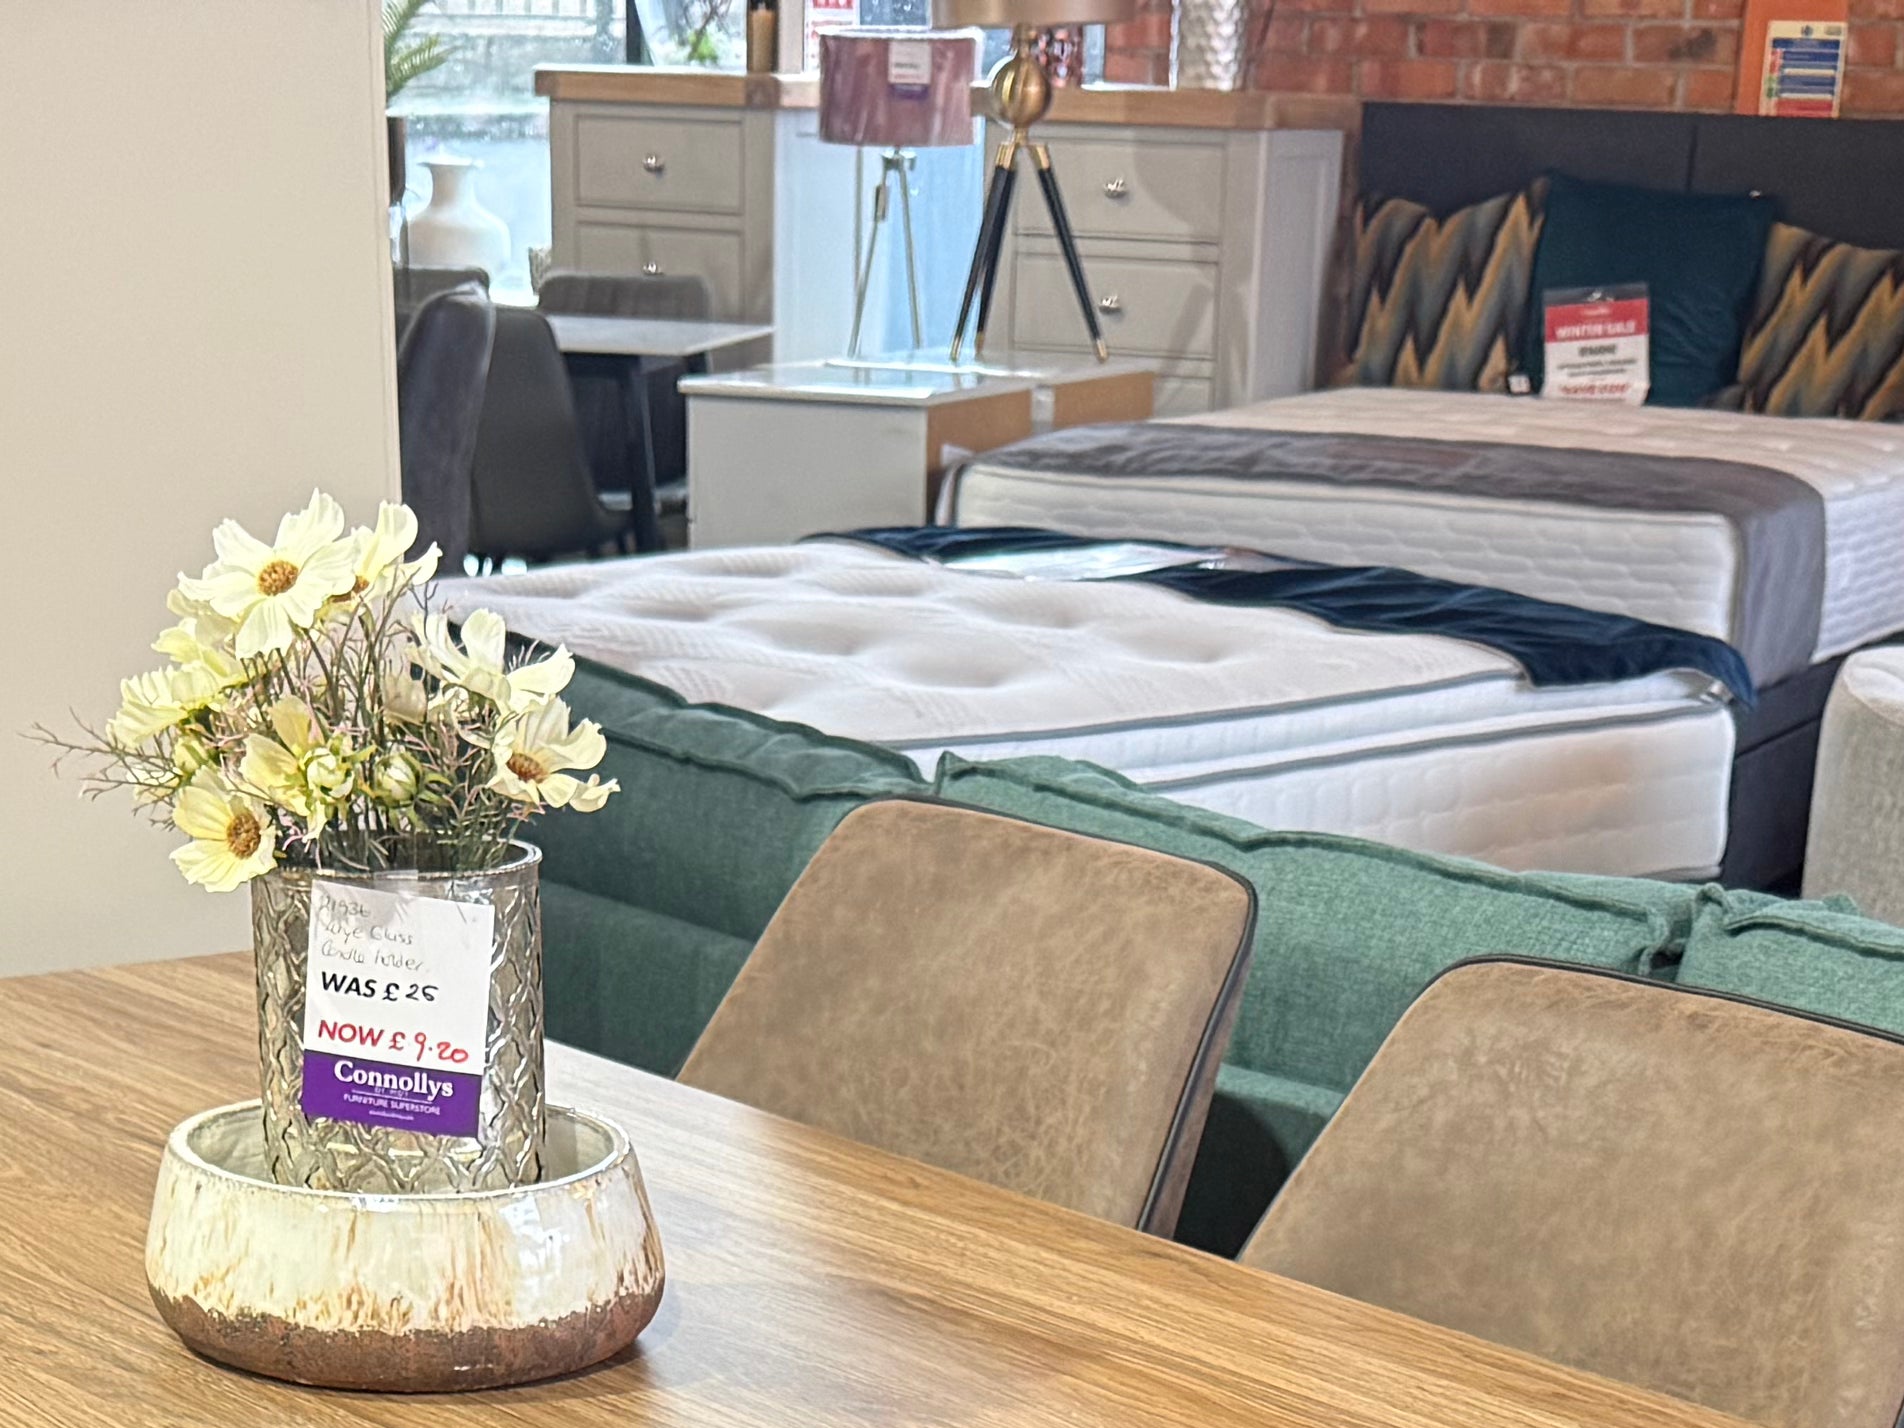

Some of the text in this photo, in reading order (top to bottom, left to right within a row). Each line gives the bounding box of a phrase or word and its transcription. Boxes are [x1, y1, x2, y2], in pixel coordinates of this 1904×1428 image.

[321, 971, 377, 998] WAS
[318, 1020, 384, 1047] NOW
[334, 1060, 454, 1101] Connollys
[343, 1093, 389, 1109] FURNITURE
[390, 1101, 441, 1116] SUPERSTORE
